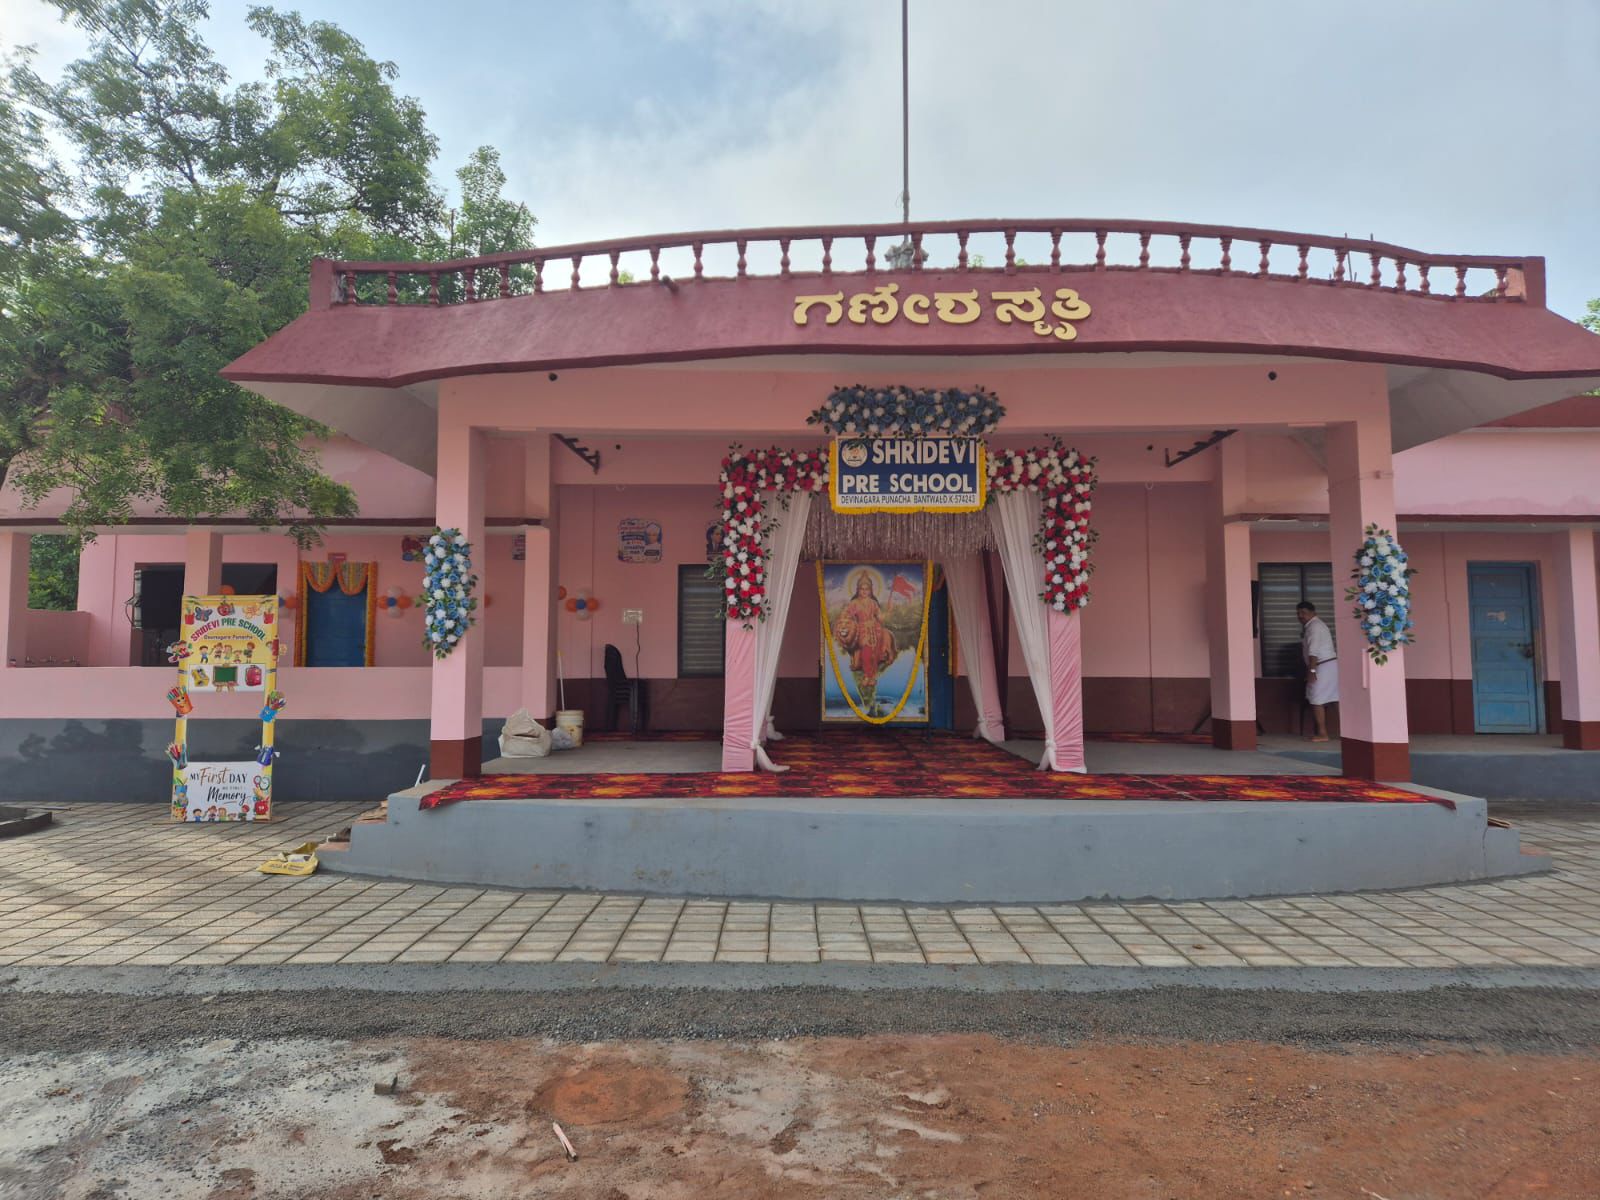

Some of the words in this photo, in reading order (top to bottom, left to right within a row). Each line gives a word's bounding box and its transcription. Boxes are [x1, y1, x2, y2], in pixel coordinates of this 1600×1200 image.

[793, 283, 982, 325] ಗಣೇಶ
[872, 439, 976, 465] SHRIDEVI
[842, 473, 880, 493] PRE
[889, 472, 973, 493] SCHOOL
[841, 494, 880, 504] DEVINAGARA
[881, 494, 911, 504] PUNACHA
[190, 619, 220, 642] SRIDEVI
[221, 617, 236, 626] PRE
[238, 619, 267, 641] SCHOOL
[200, 766, 230, 786] First
[229, 773, 248, 783] DAY
[207, 786, 248, 806] Memory
